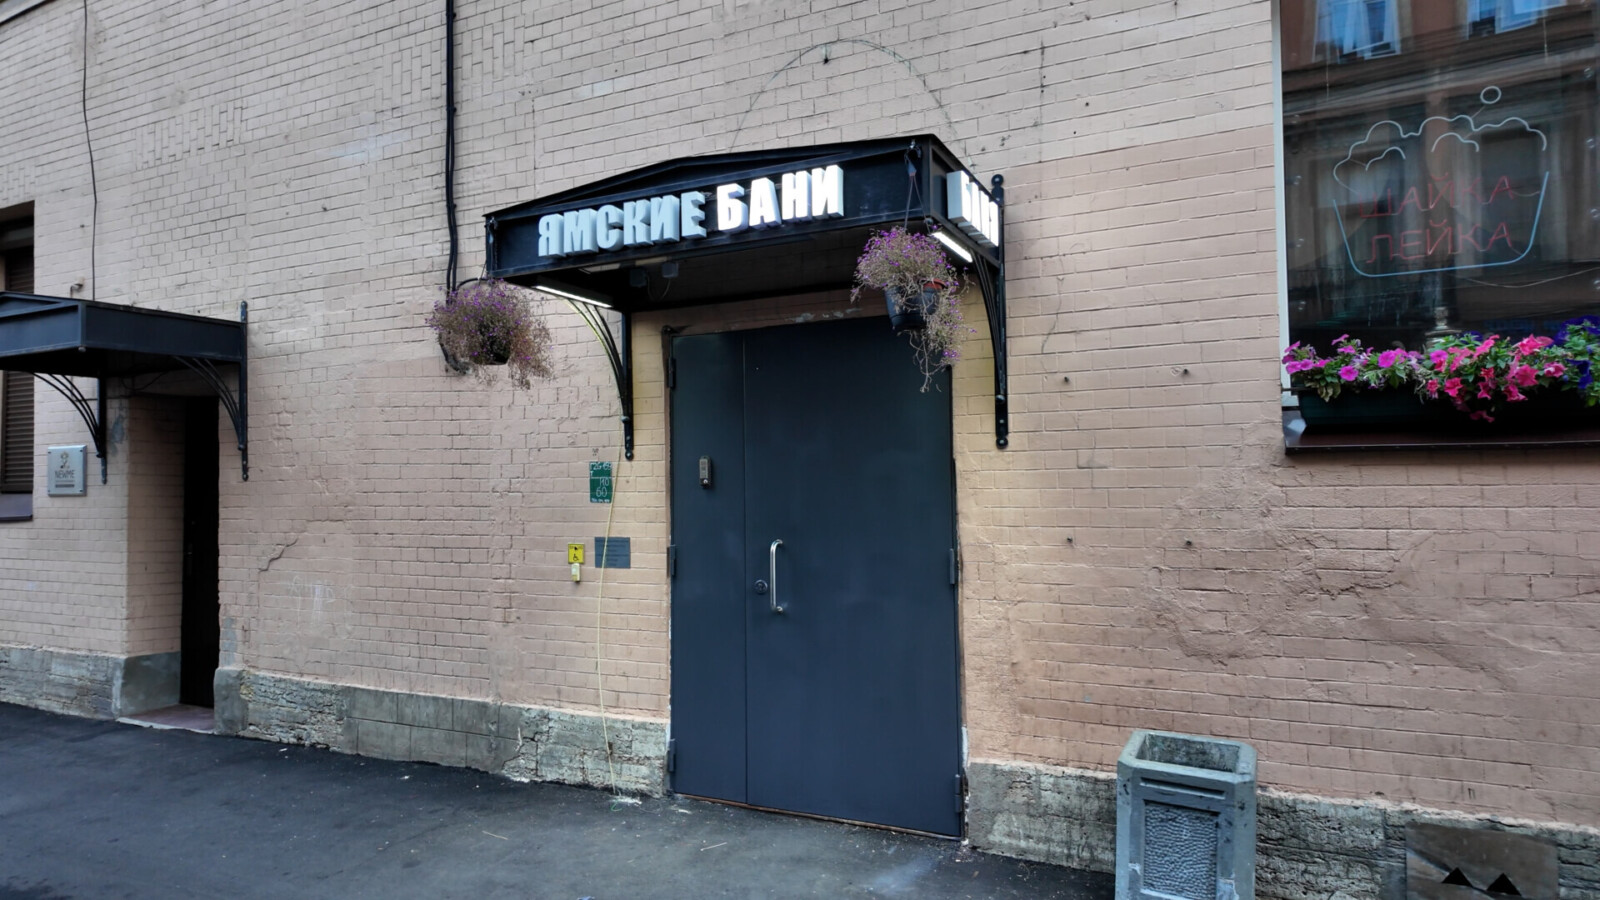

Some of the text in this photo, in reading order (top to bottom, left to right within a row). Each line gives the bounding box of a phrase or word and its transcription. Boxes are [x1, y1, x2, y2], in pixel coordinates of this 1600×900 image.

[537, 164, 844, 259] ЯМСКИЕ БАНИ
[1359, 171, 1515, 218] ШАЙКА
[1366, 219, 1513, 264] ЛЕЙКА
